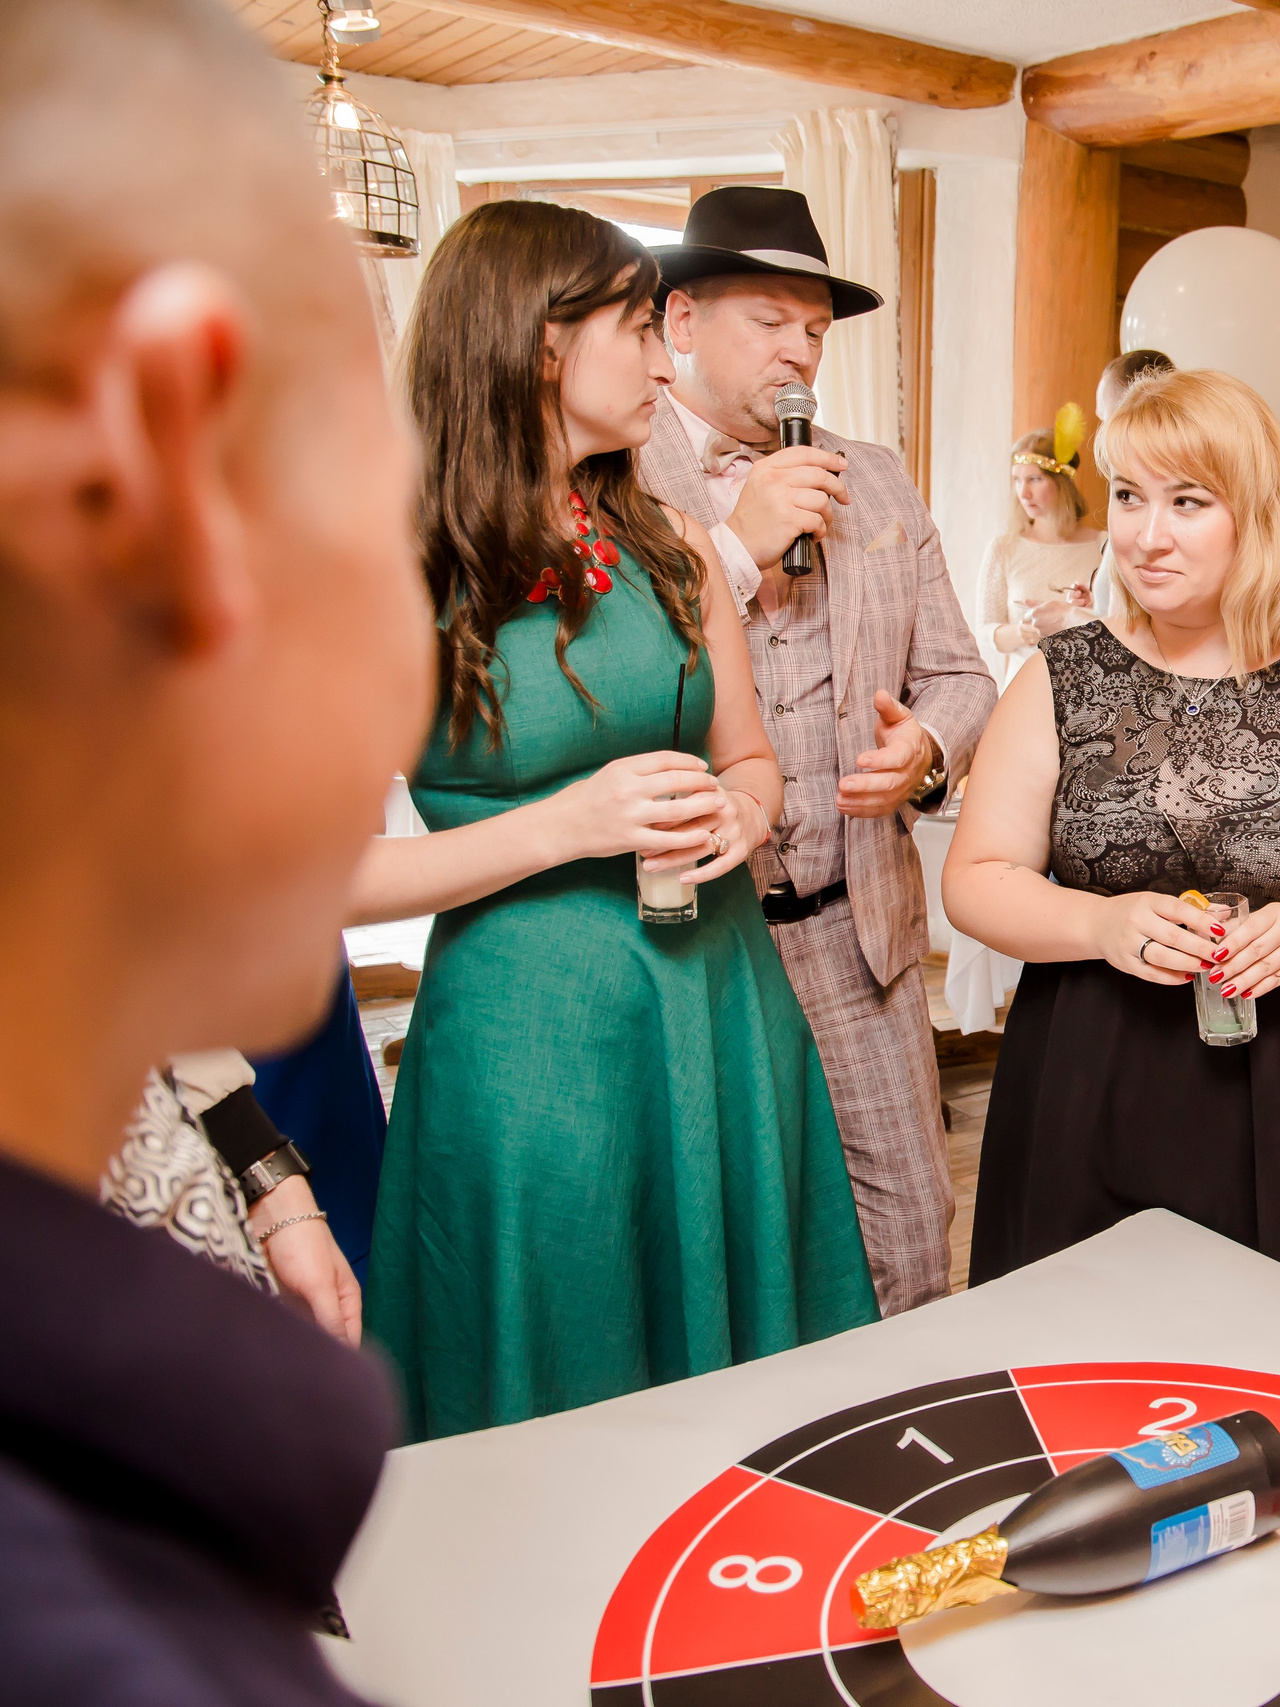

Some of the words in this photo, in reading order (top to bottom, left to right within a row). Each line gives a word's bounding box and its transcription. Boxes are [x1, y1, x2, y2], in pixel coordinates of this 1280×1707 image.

[1138, 1397, 1198, 1436] 2
[897, 1426, 954, 1465] 1
[708, 1554, 803, 1594] 8
